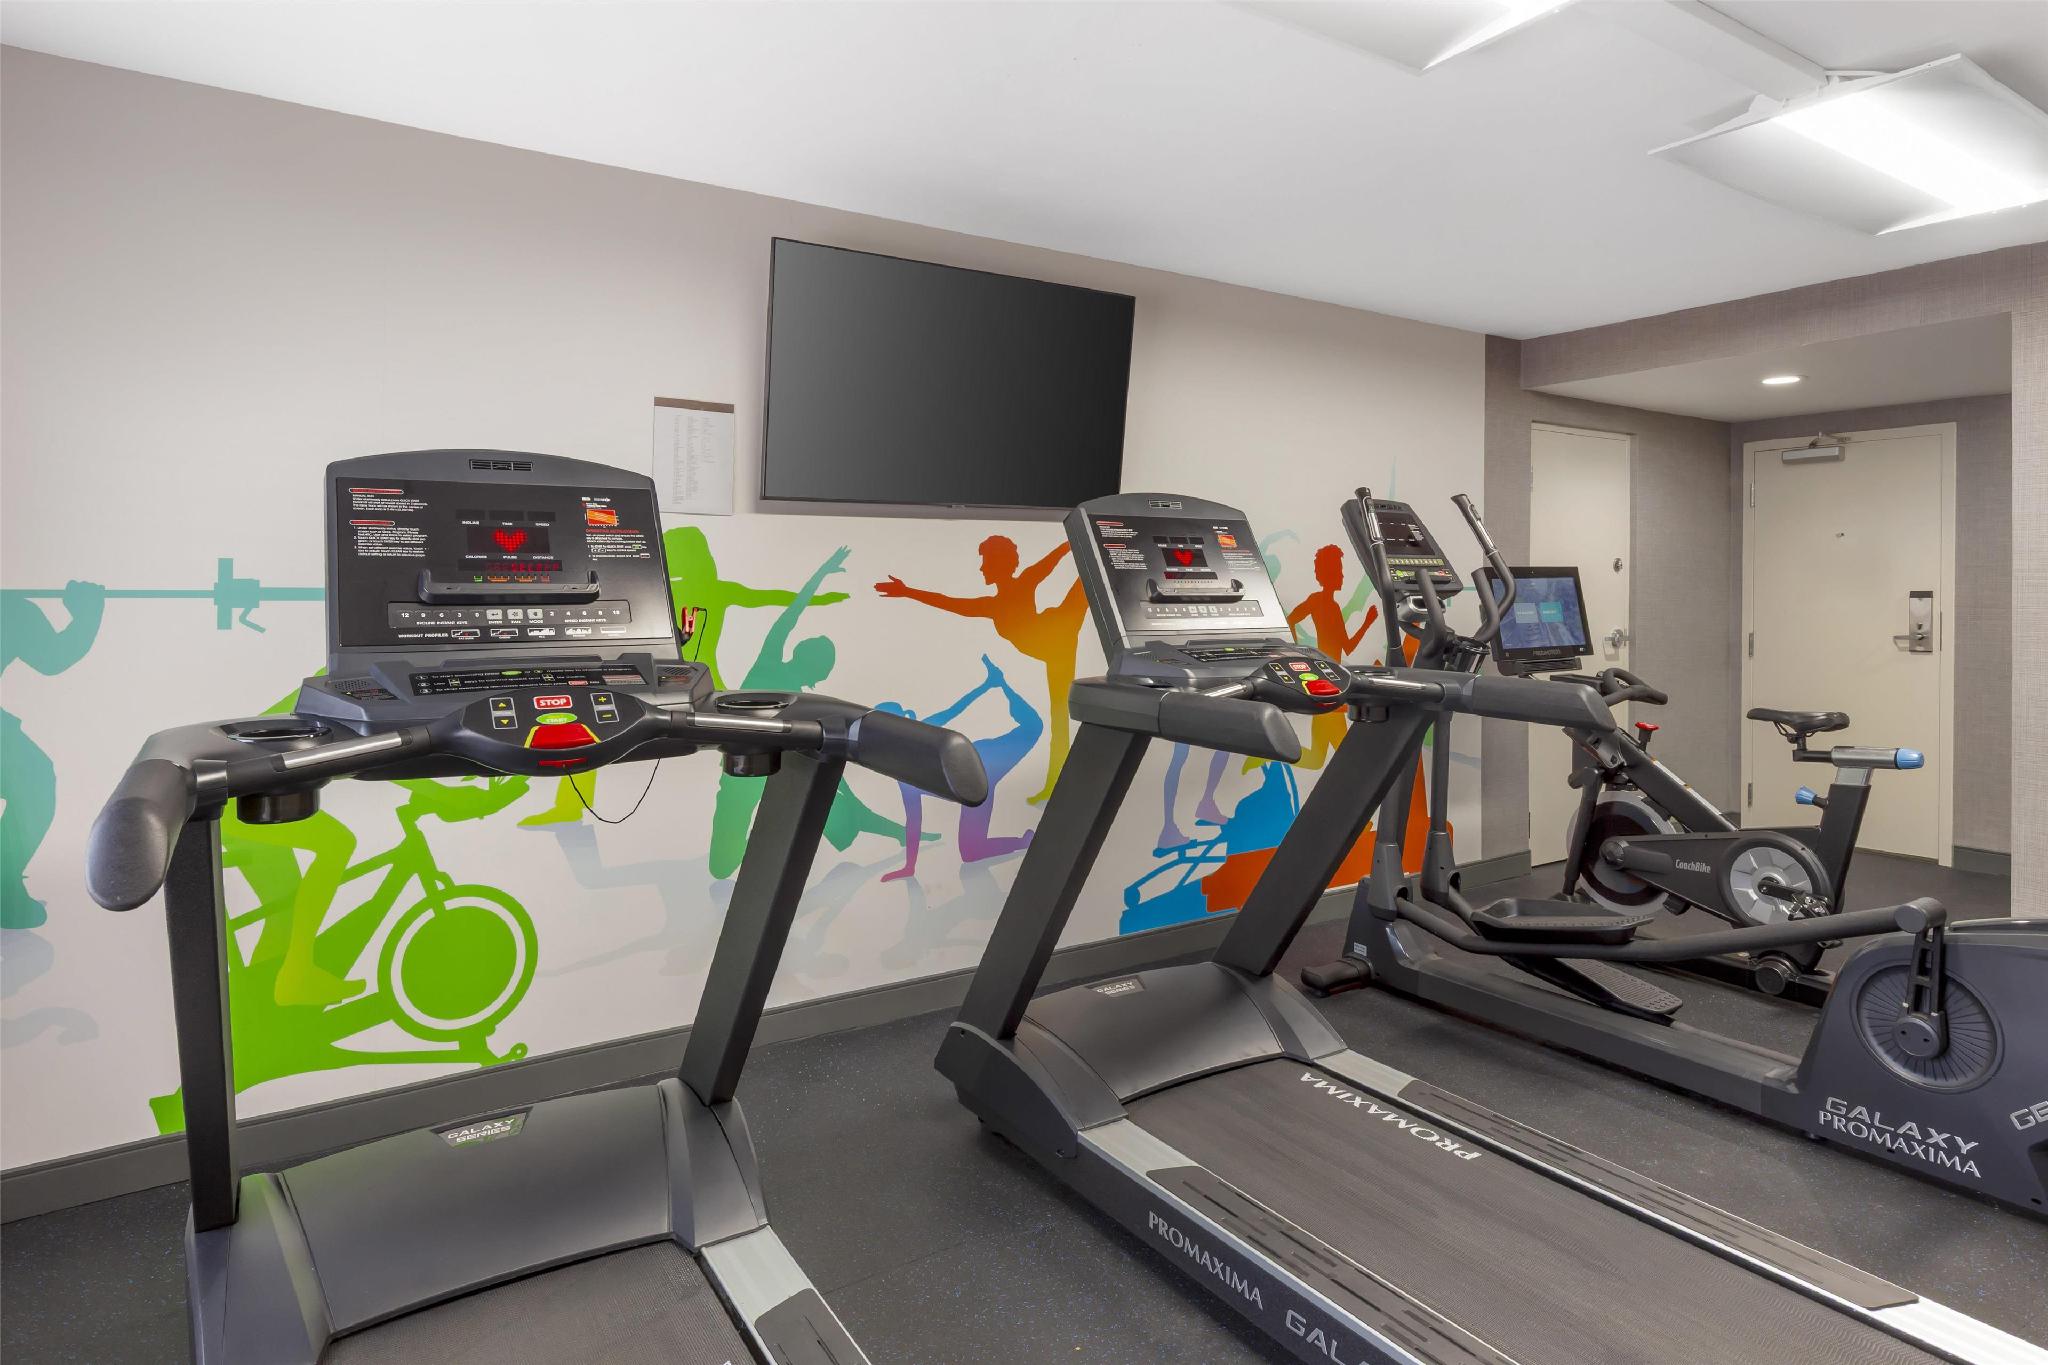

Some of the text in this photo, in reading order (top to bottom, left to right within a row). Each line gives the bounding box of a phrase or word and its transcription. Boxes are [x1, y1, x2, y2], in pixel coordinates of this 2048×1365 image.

[539, 697, 567, 707] STOP
[1675, 858, 1711, 875] CoachBike
[447, 1118, 515, 1139] GALAXY
[456, 1125, 511, 1143] SERIES
[1300, 1072, 1482, 1161] PROMAXIMA
[1825, 1096, 1979, 1155] GALAXY
[1818, 1110, 1982, 1178] PROMAXIMA
[1148, 1210, 1370, 1365] PROMAXIMA GAL
